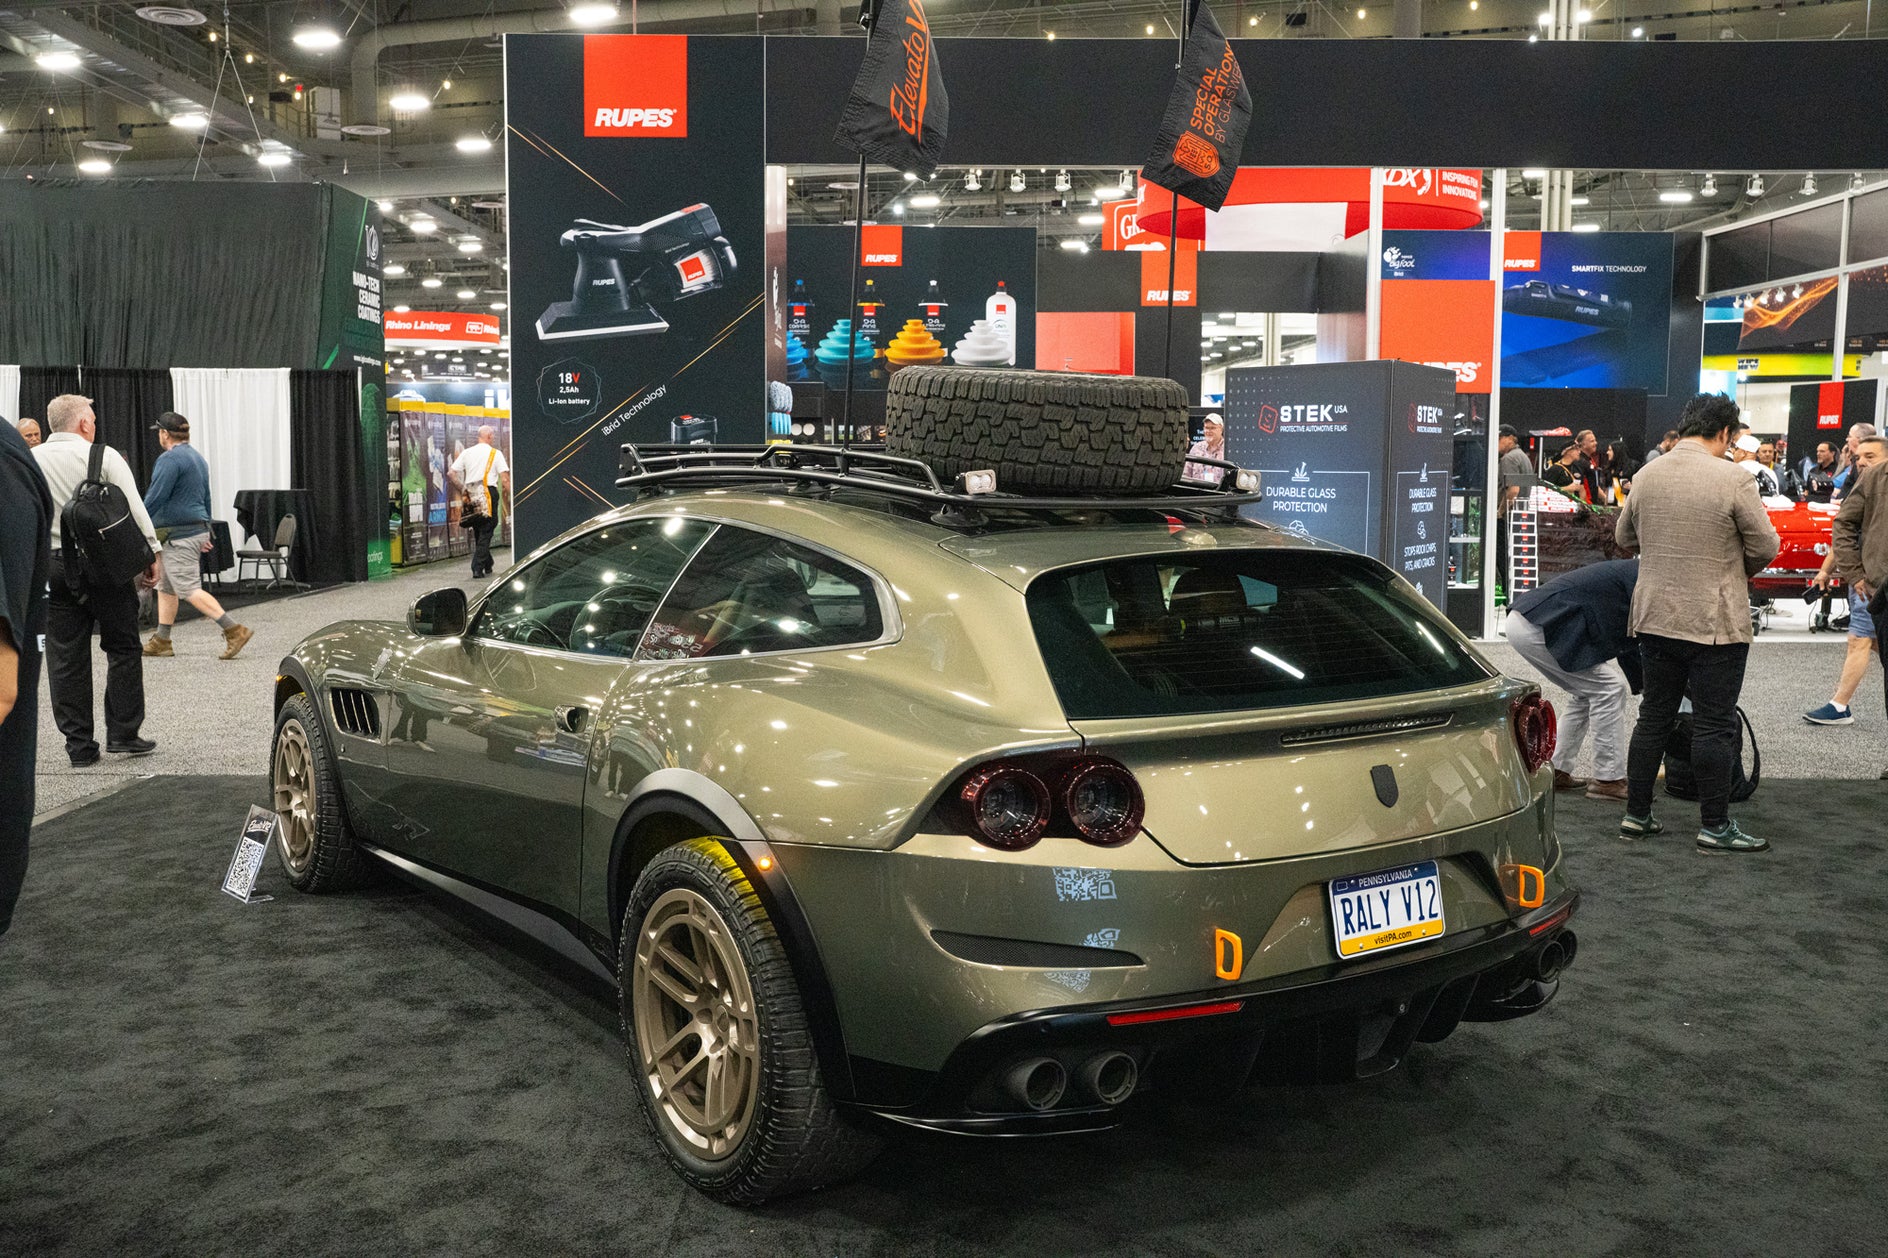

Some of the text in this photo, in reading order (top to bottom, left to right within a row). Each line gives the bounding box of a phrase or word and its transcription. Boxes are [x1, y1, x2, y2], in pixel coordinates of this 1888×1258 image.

[1190, 67, 1217, 130] SPECIAL
[594, 108, 673, 128] RUPES
[1215, 124, 1226, 143] BY
[865, 254, 898, 263] RUPES
[1504, 259, 1536, 268] RUPES
[1571, 265, 1647, 273] SMARTFIX TECHNOLOGY
[385, 320, 451, 332] Rhino Linings
[558, 372, 581, 384] 18V
[559, 386, 579, 394] 2,5Ah
[568, 398, 590, 406] battery
[601, 384, 667, 436] iBrid Technology
[1280, 404, 1348, 422] STEK USA
[1334, 424, 1348, 432] FILMS
[1266, 487, 1336, 498] DURABLE GLASS
[1273, 502, 1327, 513] PROTECTION
[1411, 502, 1434, 513] PROTECTION
[1358, 869, 1413, 887] PENNSYLVANIA
[1340, 879, 1439, 936] RALY V12
[1374, 930, 1412, 945] visitPA.com
